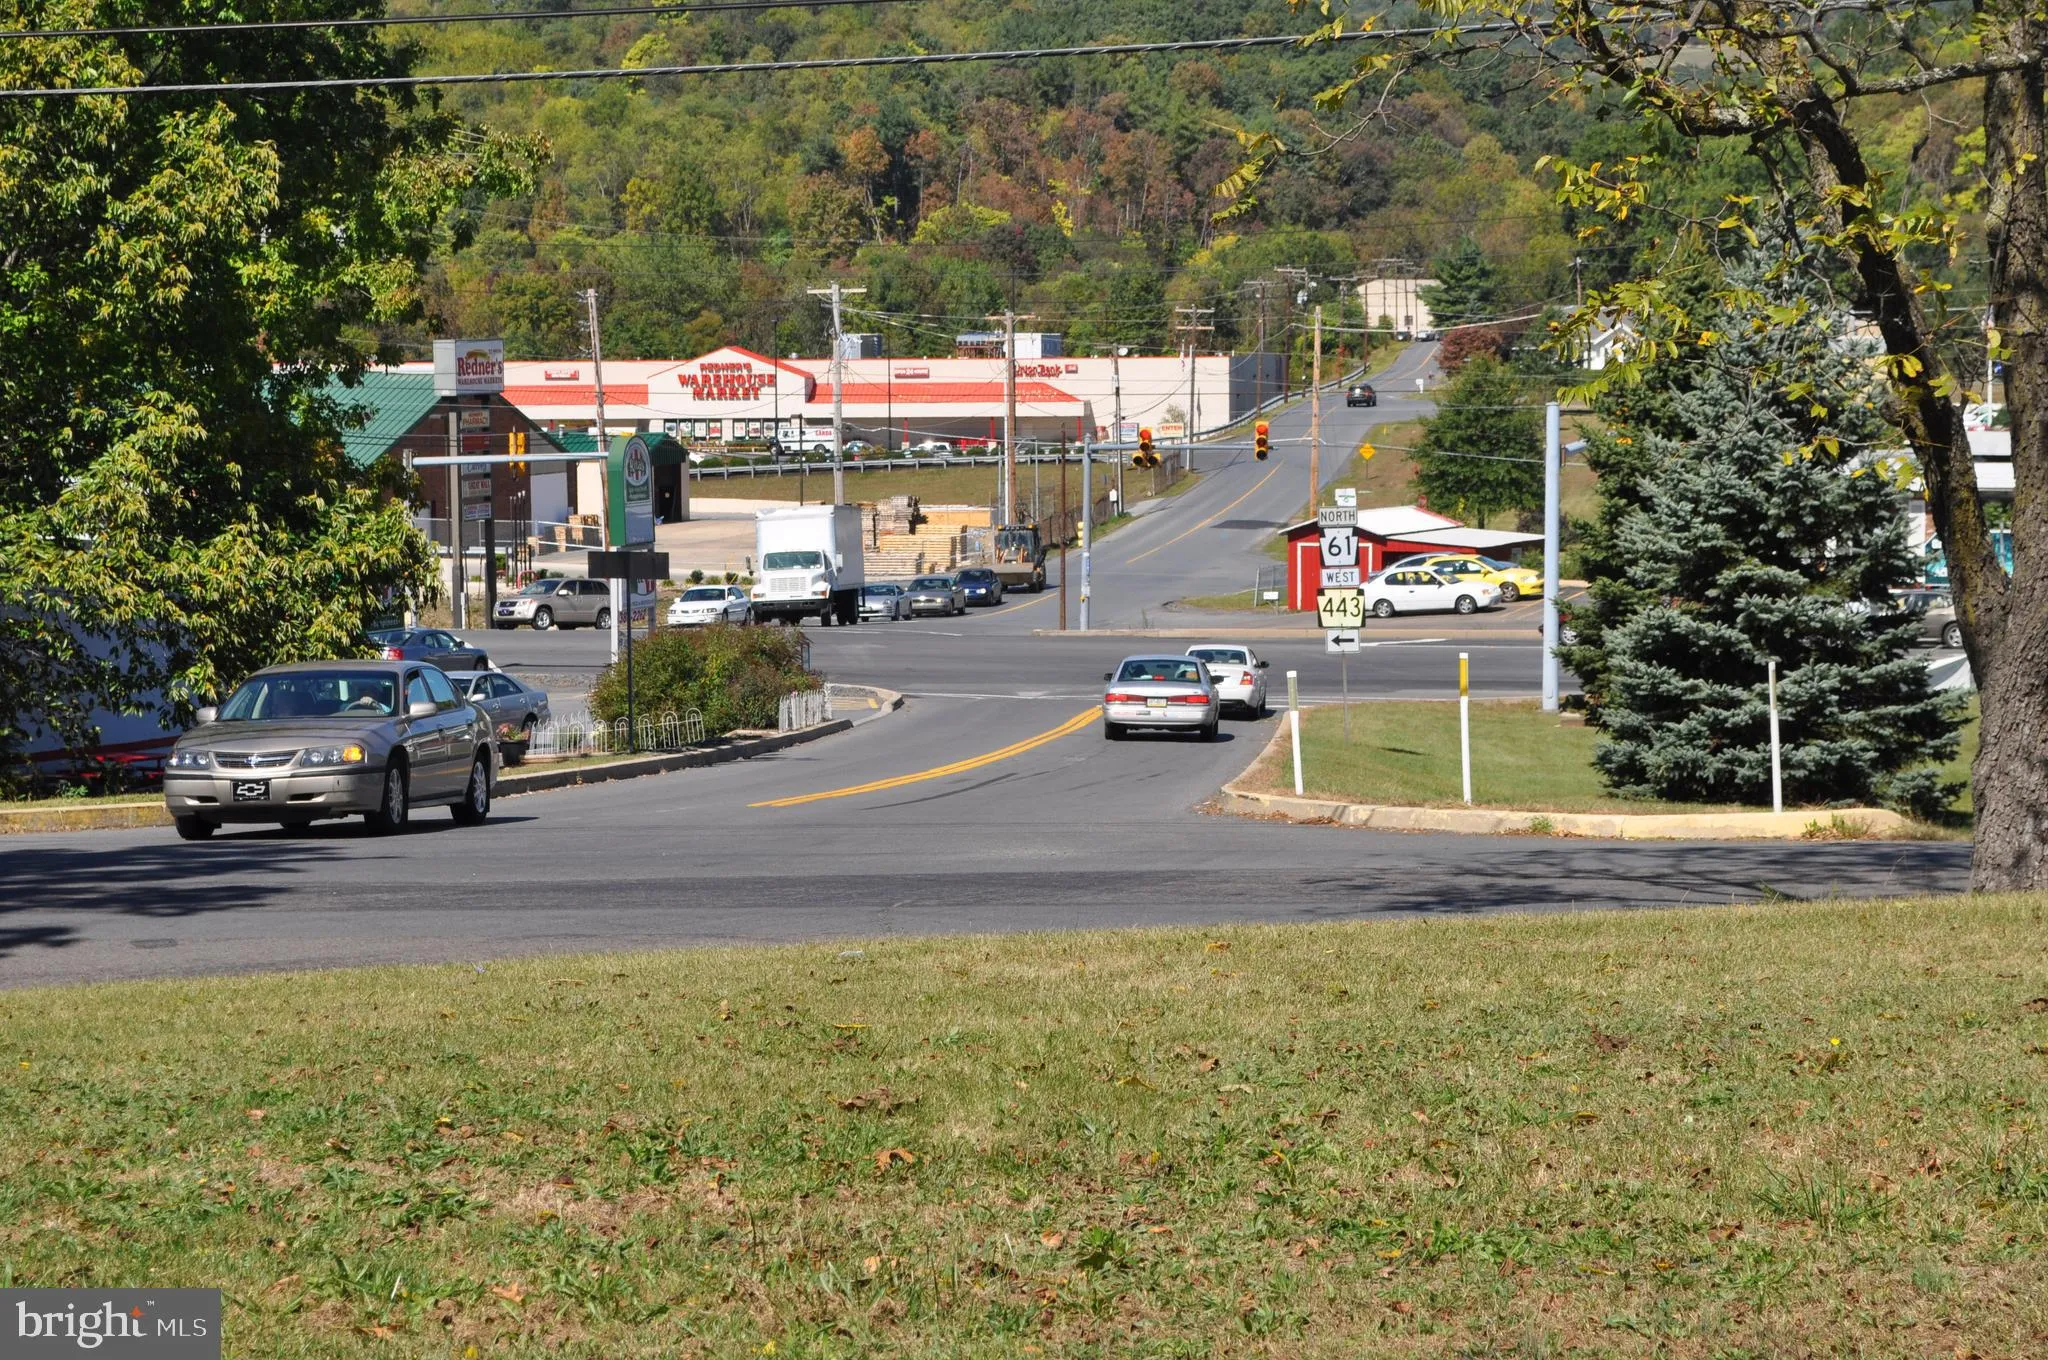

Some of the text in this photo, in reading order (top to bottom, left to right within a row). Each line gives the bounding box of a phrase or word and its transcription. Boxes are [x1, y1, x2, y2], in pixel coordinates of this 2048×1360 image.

[457, 357, 503, 376] Redner's
[700, 363, 753, 373] REDNER'S
[678, 374, 776, 388] WAREHOUSE
[692, 386, 760, 401] MARKET
[1320, 511, 1355, 522] NORTH
[1328, 535, 1351, 556] 61
[1327, 572, 1354, 583] WEST
[1322, 597, 1361, 617] 443
